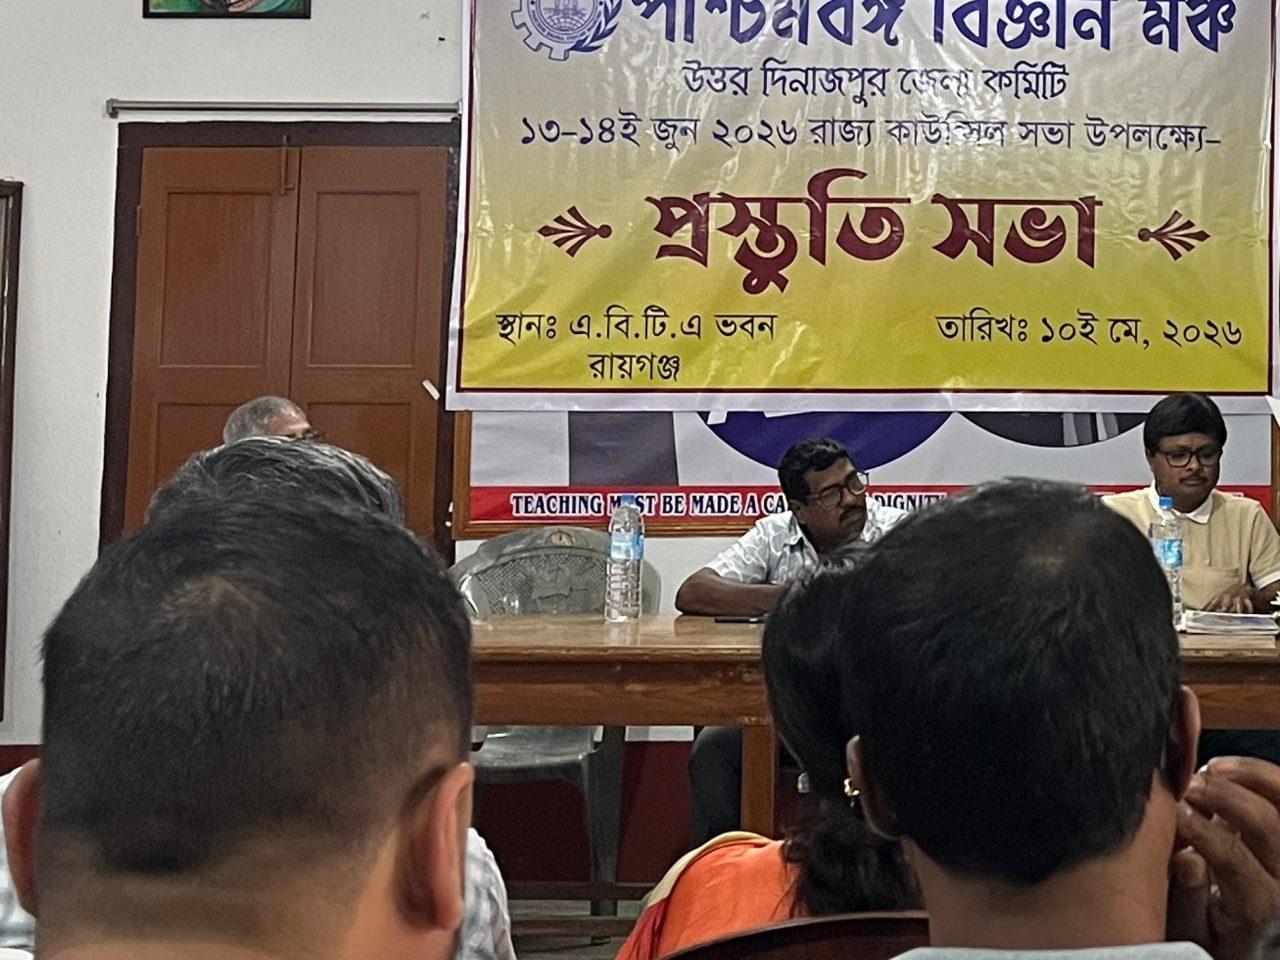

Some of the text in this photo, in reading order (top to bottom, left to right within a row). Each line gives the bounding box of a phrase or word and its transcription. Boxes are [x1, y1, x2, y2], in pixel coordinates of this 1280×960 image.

[682, 58, 1070, 107] উত্তর দিনাজপুর জেলা কমিটি
[650, 118, 701, 152] জুন
[712, 119, 797, 148] ২০২৬
[808, 117, 876, 147] রাজ্য
[1018, 119, 1075, 149] সভা
[644, 167, 1103, 295] প্রস্তুতি সভা
[570, 304, 702, 340] এ.বি.টি.এ
[714, 313, 778, 340] ভবন
[1041, 308, 1099, 345] ১০ই
[1107, 317, 1150, 350] মে,
[1163, 319, 1242, 348] ২০২৬
[588, 352, 681, 381] রায়গঞ্জ
[512, 494, 603, 515] TEACHING
[609, 494, 657, 515] MST
[661, 494, 685, 515] BE
[690, 494, 740, 515] MADE
[745, 494, 758, 515] A
